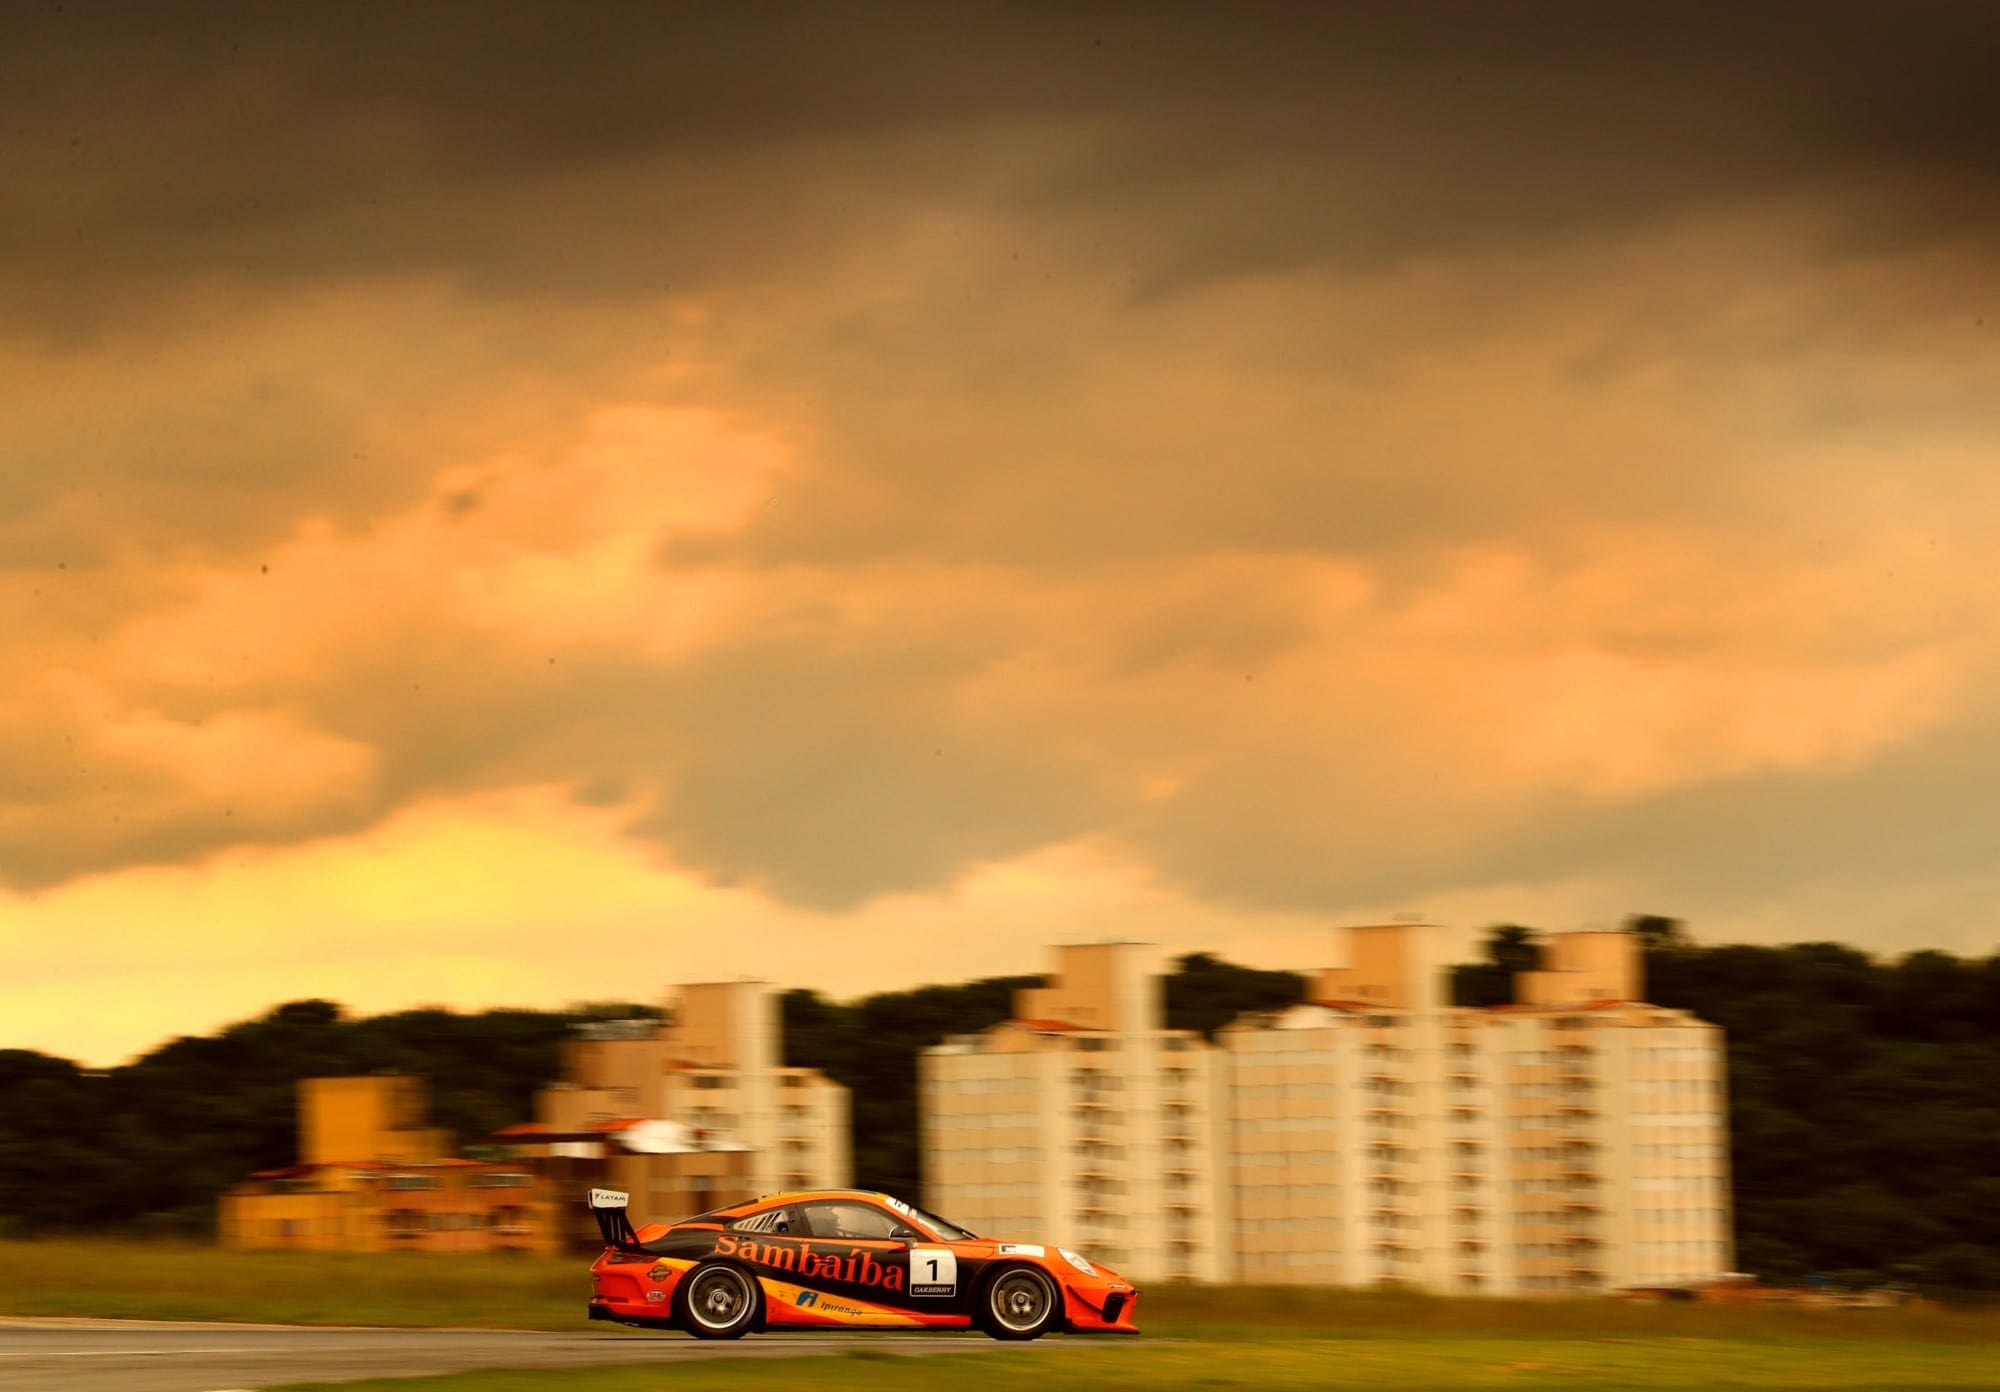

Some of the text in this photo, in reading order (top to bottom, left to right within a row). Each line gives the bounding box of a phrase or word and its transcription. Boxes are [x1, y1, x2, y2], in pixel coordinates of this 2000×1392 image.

[714, 1234, 904, 1290] Sambaíba
[926, 1259, 938, 1281] 1
[914, 1286, 952, 1294] OAKBERRY
